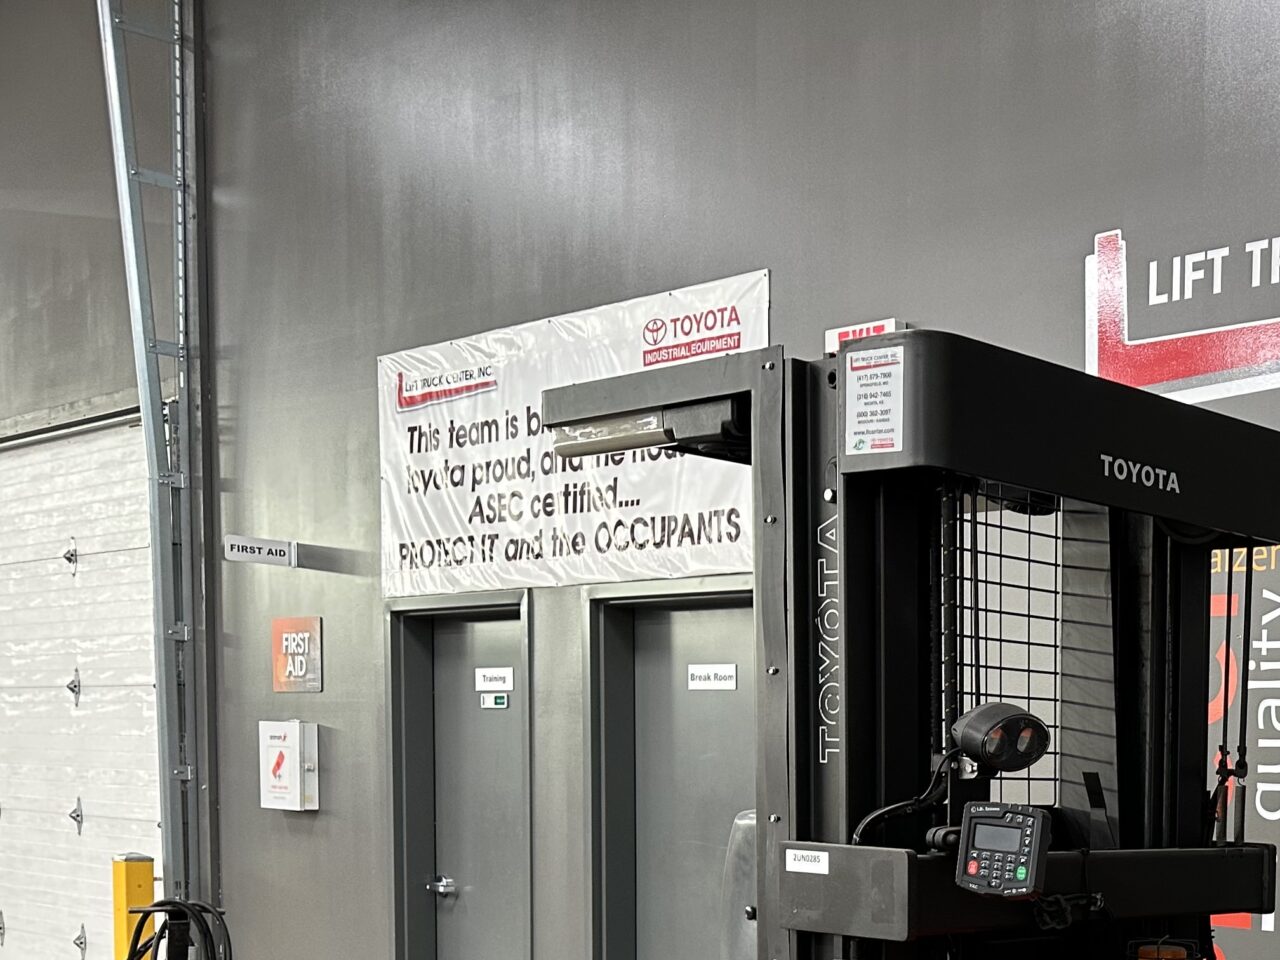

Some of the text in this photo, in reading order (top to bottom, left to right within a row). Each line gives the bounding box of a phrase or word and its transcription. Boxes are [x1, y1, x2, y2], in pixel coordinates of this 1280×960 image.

[1147, 248, 1231, 306] LIFT
[670, 305, 741, 338] TOYOTA
[645, 335, 739, 364] INDUSTRIAL EQUIPMENT
[421, 375, 443, 390] TRUCK
[407, 422, 440, 454] This
[448, 419, 499, 449] team
[505, 409, 519, 440] is
[471, 448, 536, 492] proud,
[1100, 453, 1180, 494] TOYOTA
[467, 490, 524, 524] ASEC
[229, 543, 287, 558] FIRST AID
[481, 533, 499, 563] IT
[504, 528, 543, 562] and
[551, 527, 586, 557] the
[594, 507, 741, 554] OCCUPANTS
[282, 632, 310, 654] FIRST
[817, 514, 840, 764] TOYOTA
[285, 655, 307, 677] AID
[482, 674, 506, 684] Training
[690, 672, 734, 681] Break Room
